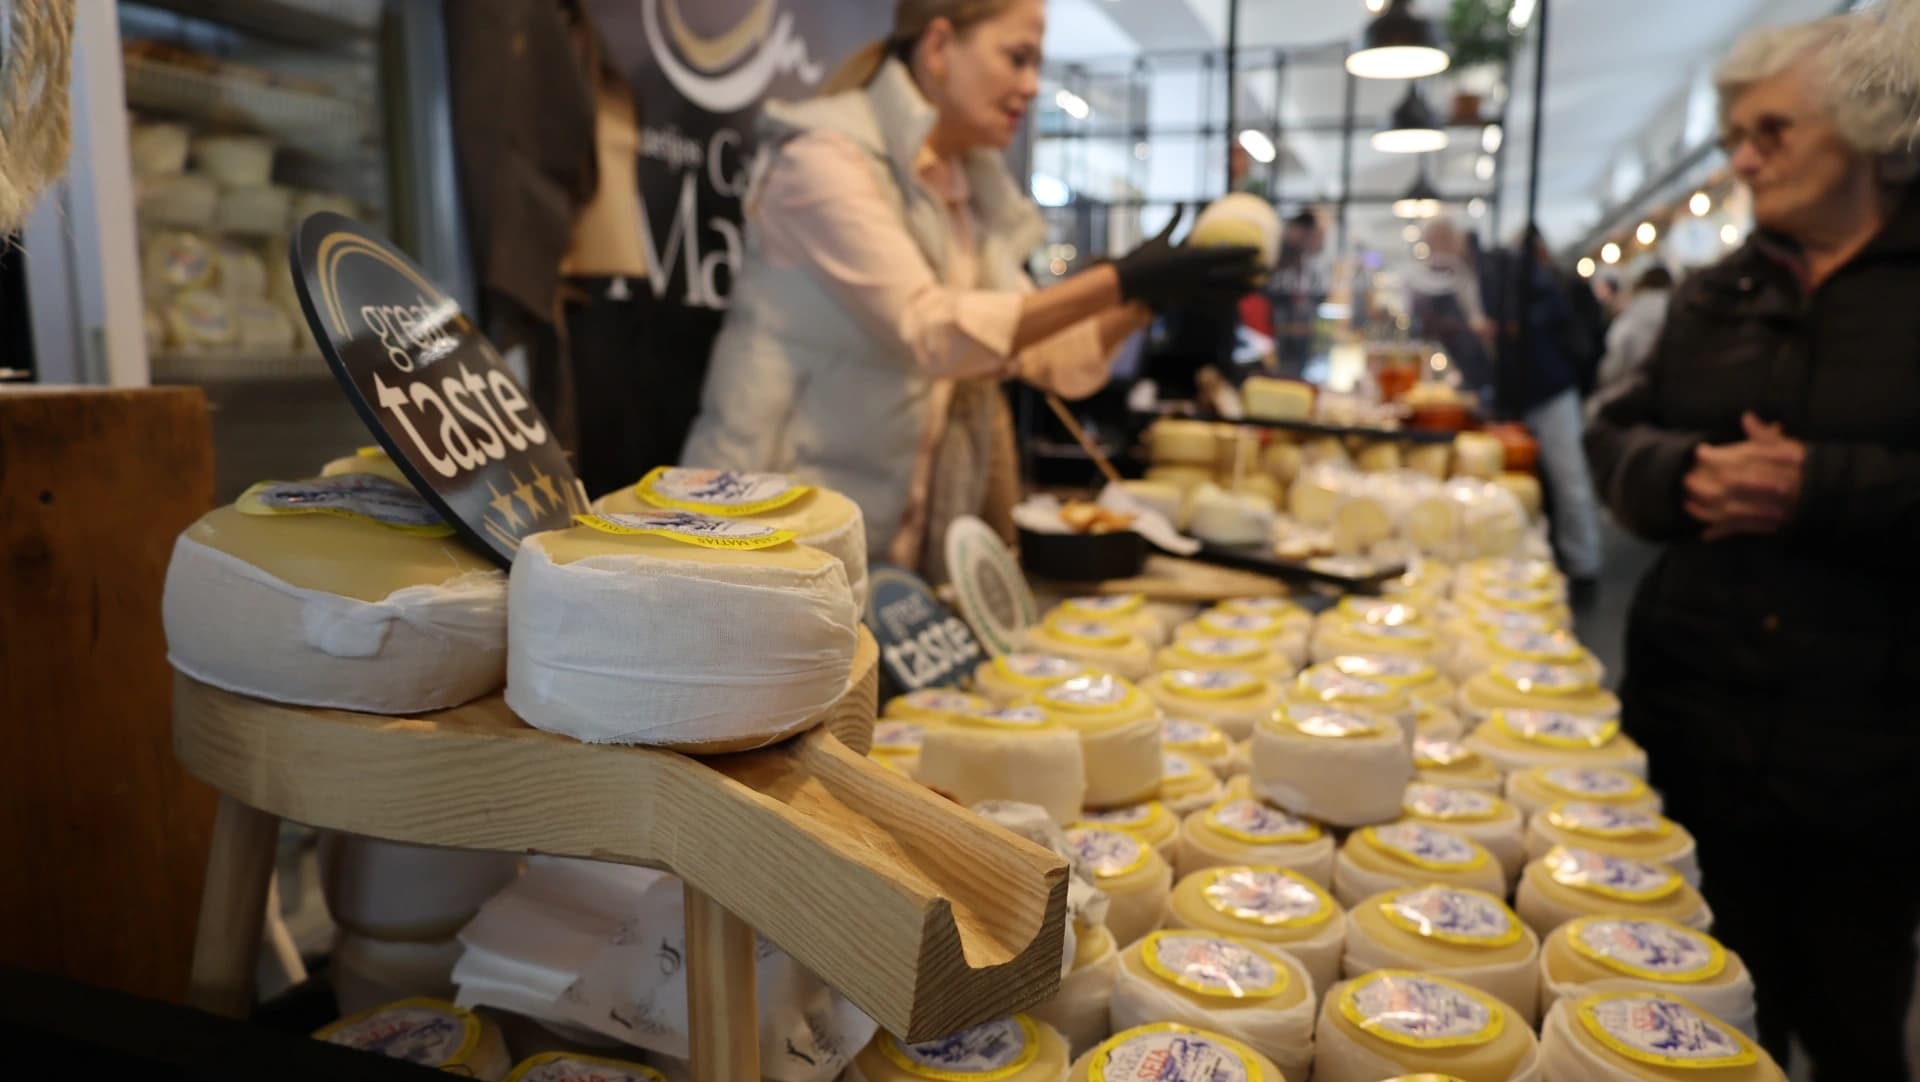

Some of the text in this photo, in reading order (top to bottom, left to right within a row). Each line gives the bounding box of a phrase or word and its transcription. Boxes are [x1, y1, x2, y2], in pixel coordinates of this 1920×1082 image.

[607, 173, 743, 309] Ma
[373, 362, 547, 477] taste
[883, 616, 978, 687] taste
